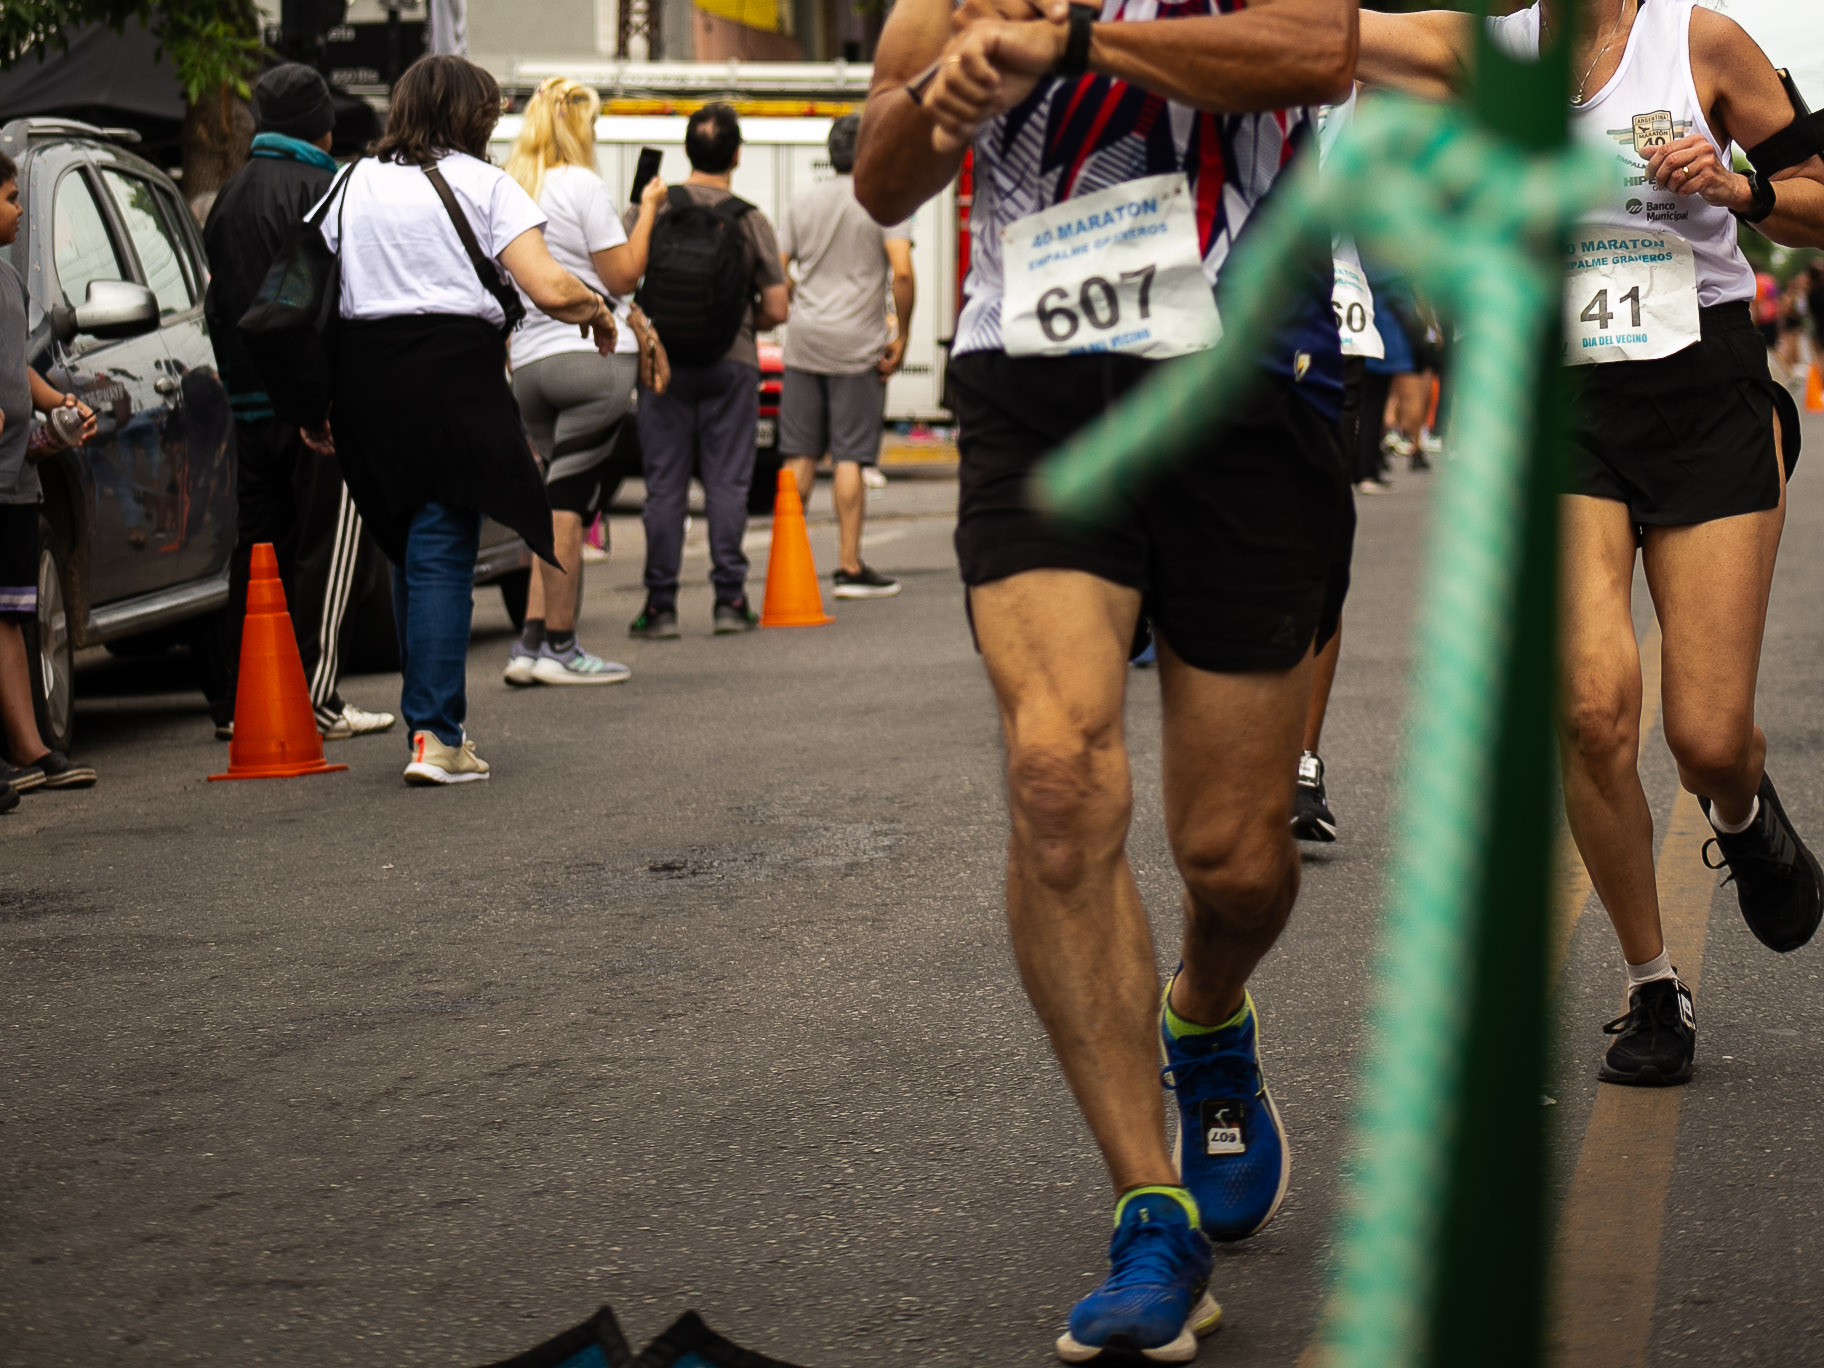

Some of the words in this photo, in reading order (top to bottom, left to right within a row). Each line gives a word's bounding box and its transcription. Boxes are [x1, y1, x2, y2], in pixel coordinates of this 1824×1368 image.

[1637, 115, 1667, 124] ARGENTINA
[1624, 175, 1657, 187] HIPE
[1646, 202, 1675, 212] Banco
[1646, 210, 1689, 222] Municipal
[1032, 229, 1053, 249] 40
[1056, 198, 1158, 240] MARATON
[1580, 238, 1666, 253] MARATON
[1568, 257, 1609, 270] PALME
[1036, 264, 1156, 342] 607
[1580, 286, 1641, 329] 41
[1582, 337, 1597, 348] DIA
[1599, 335, 1614, 346] DEL
[1616, 333, 1648, 344] VECINO
